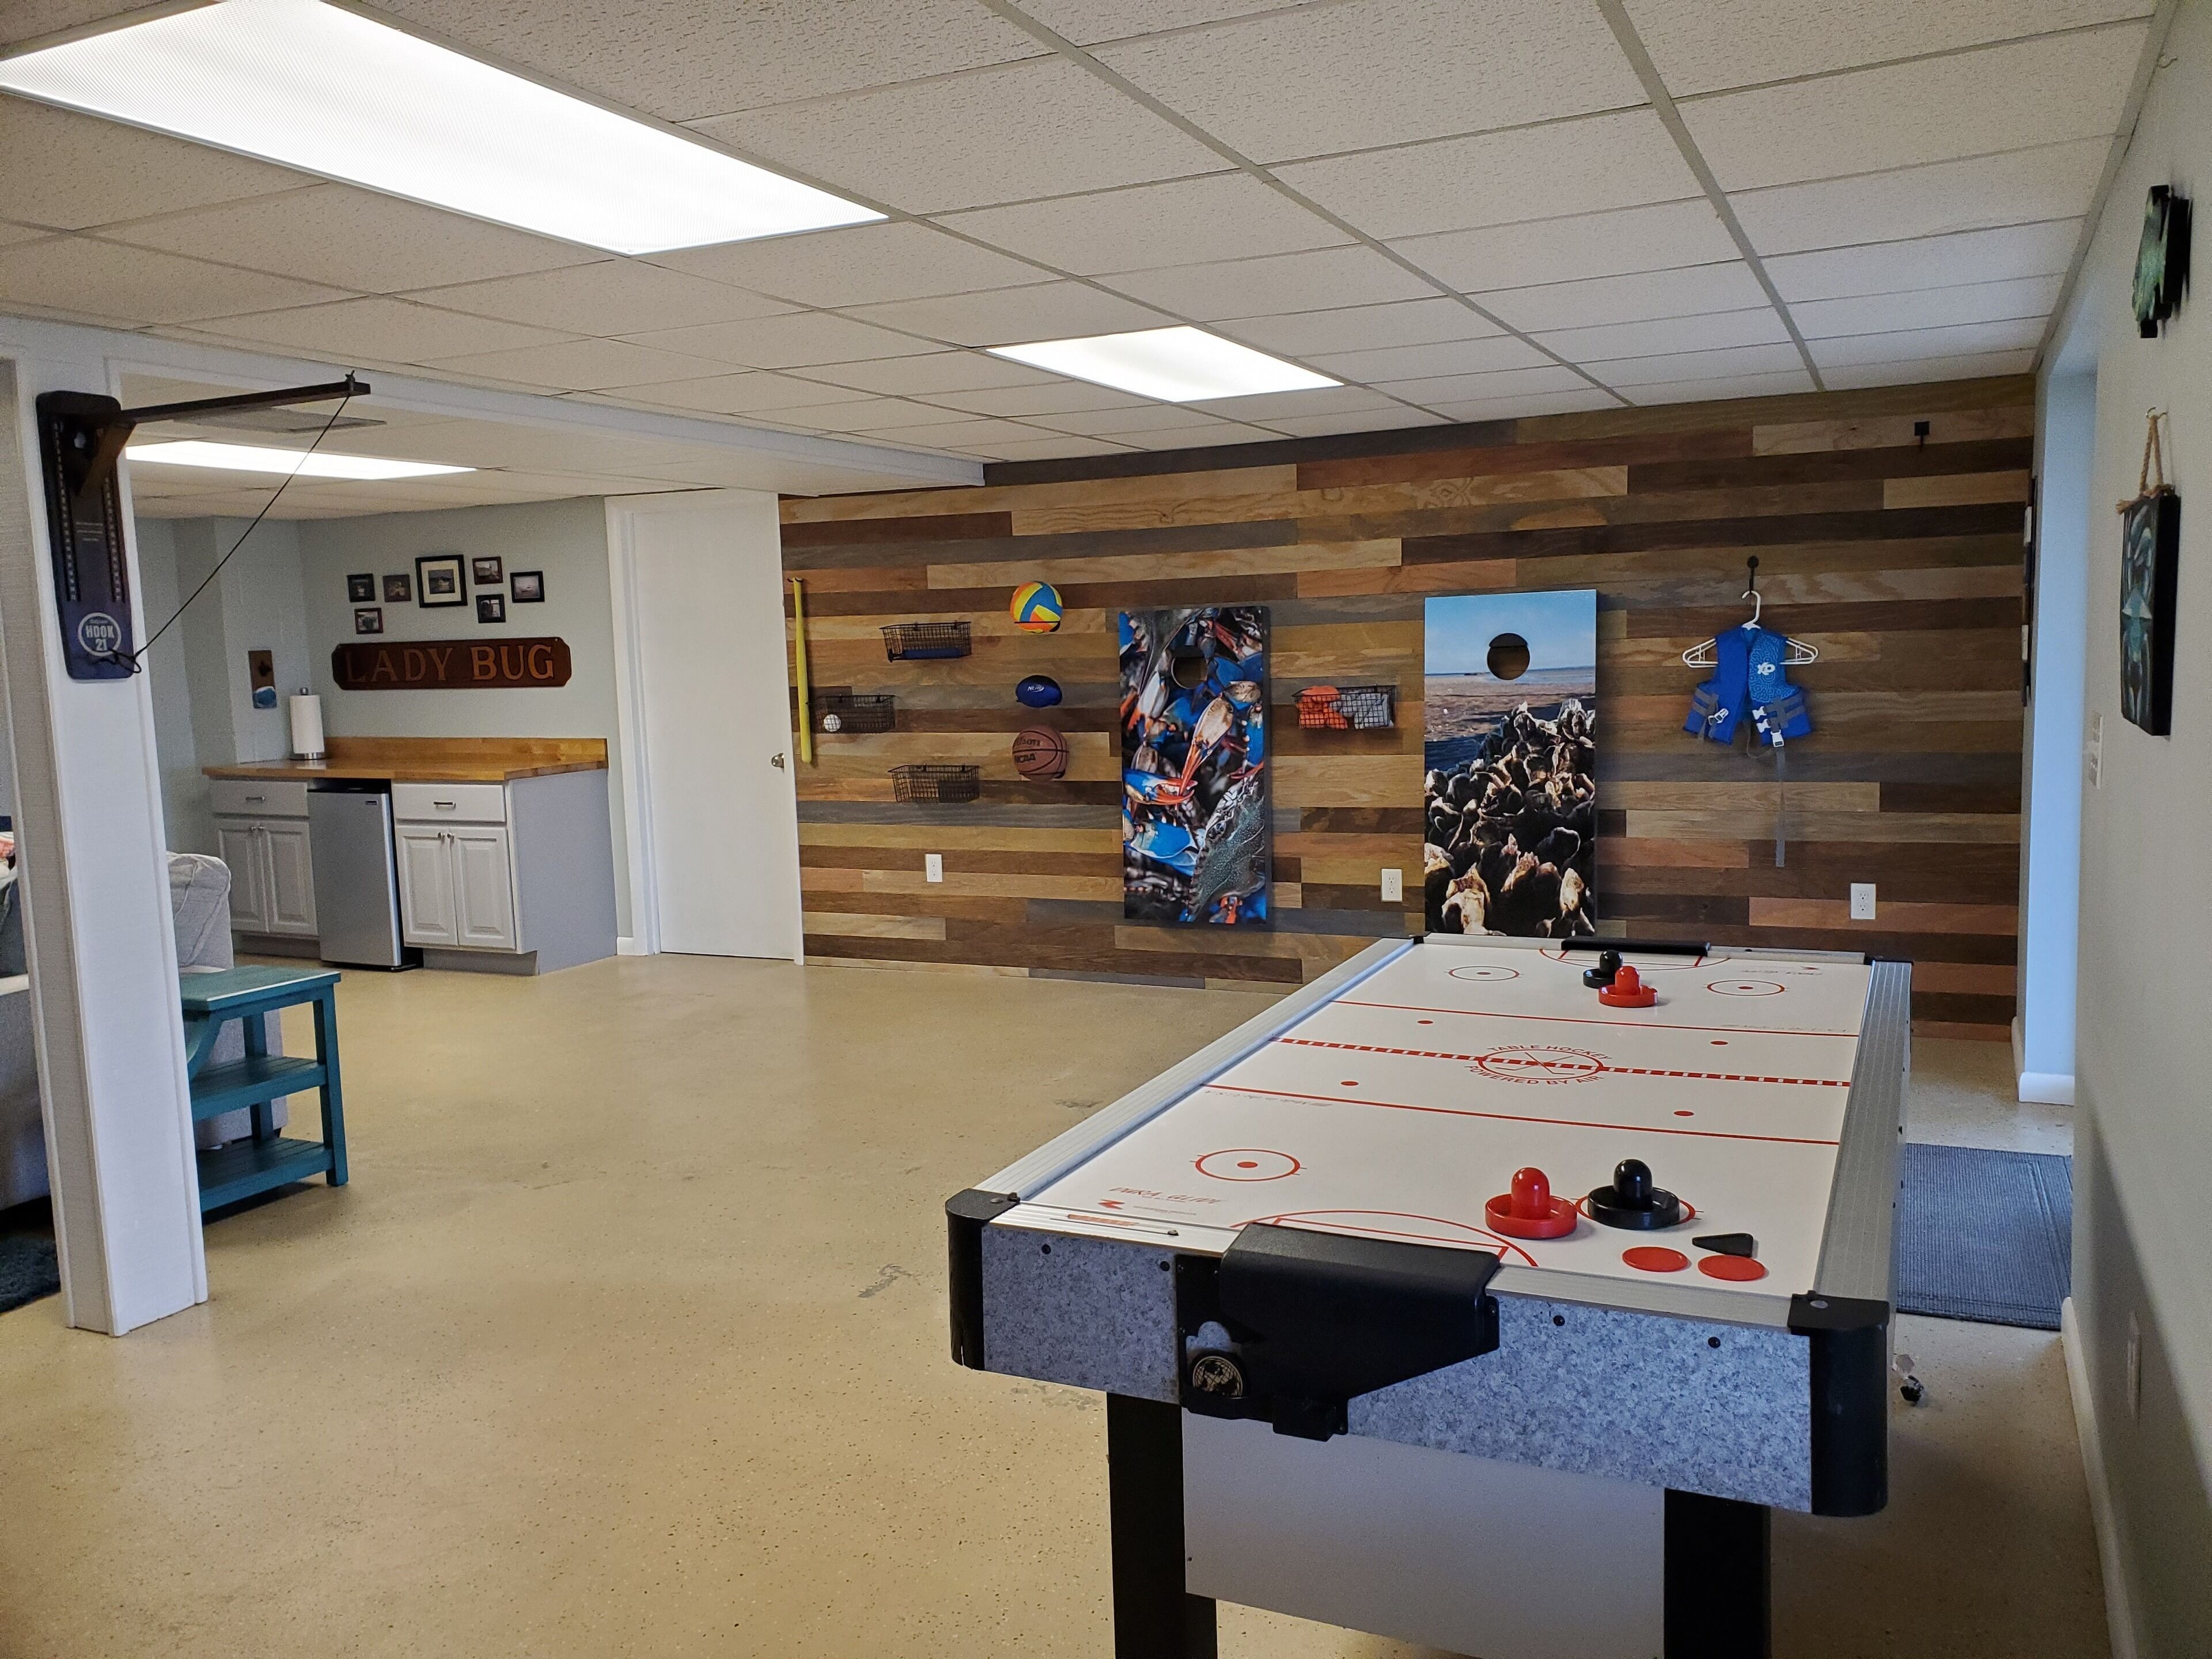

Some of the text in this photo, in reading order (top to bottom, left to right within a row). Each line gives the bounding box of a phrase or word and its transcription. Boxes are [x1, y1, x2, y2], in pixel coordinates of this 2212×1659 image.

[85, 625, 115, 638] HOOK
[95, 638, 108, 651] 21
[346, 644, 554, 682] LADY BUG
[1014, 753, 1036, 763] NCAA
[1486, 1044, 1613, 1060] TABLE HOCKEY
[1464, 1065, 1540, 1085] POWERED
[1576, 1075, 1604, 1084] AIR
